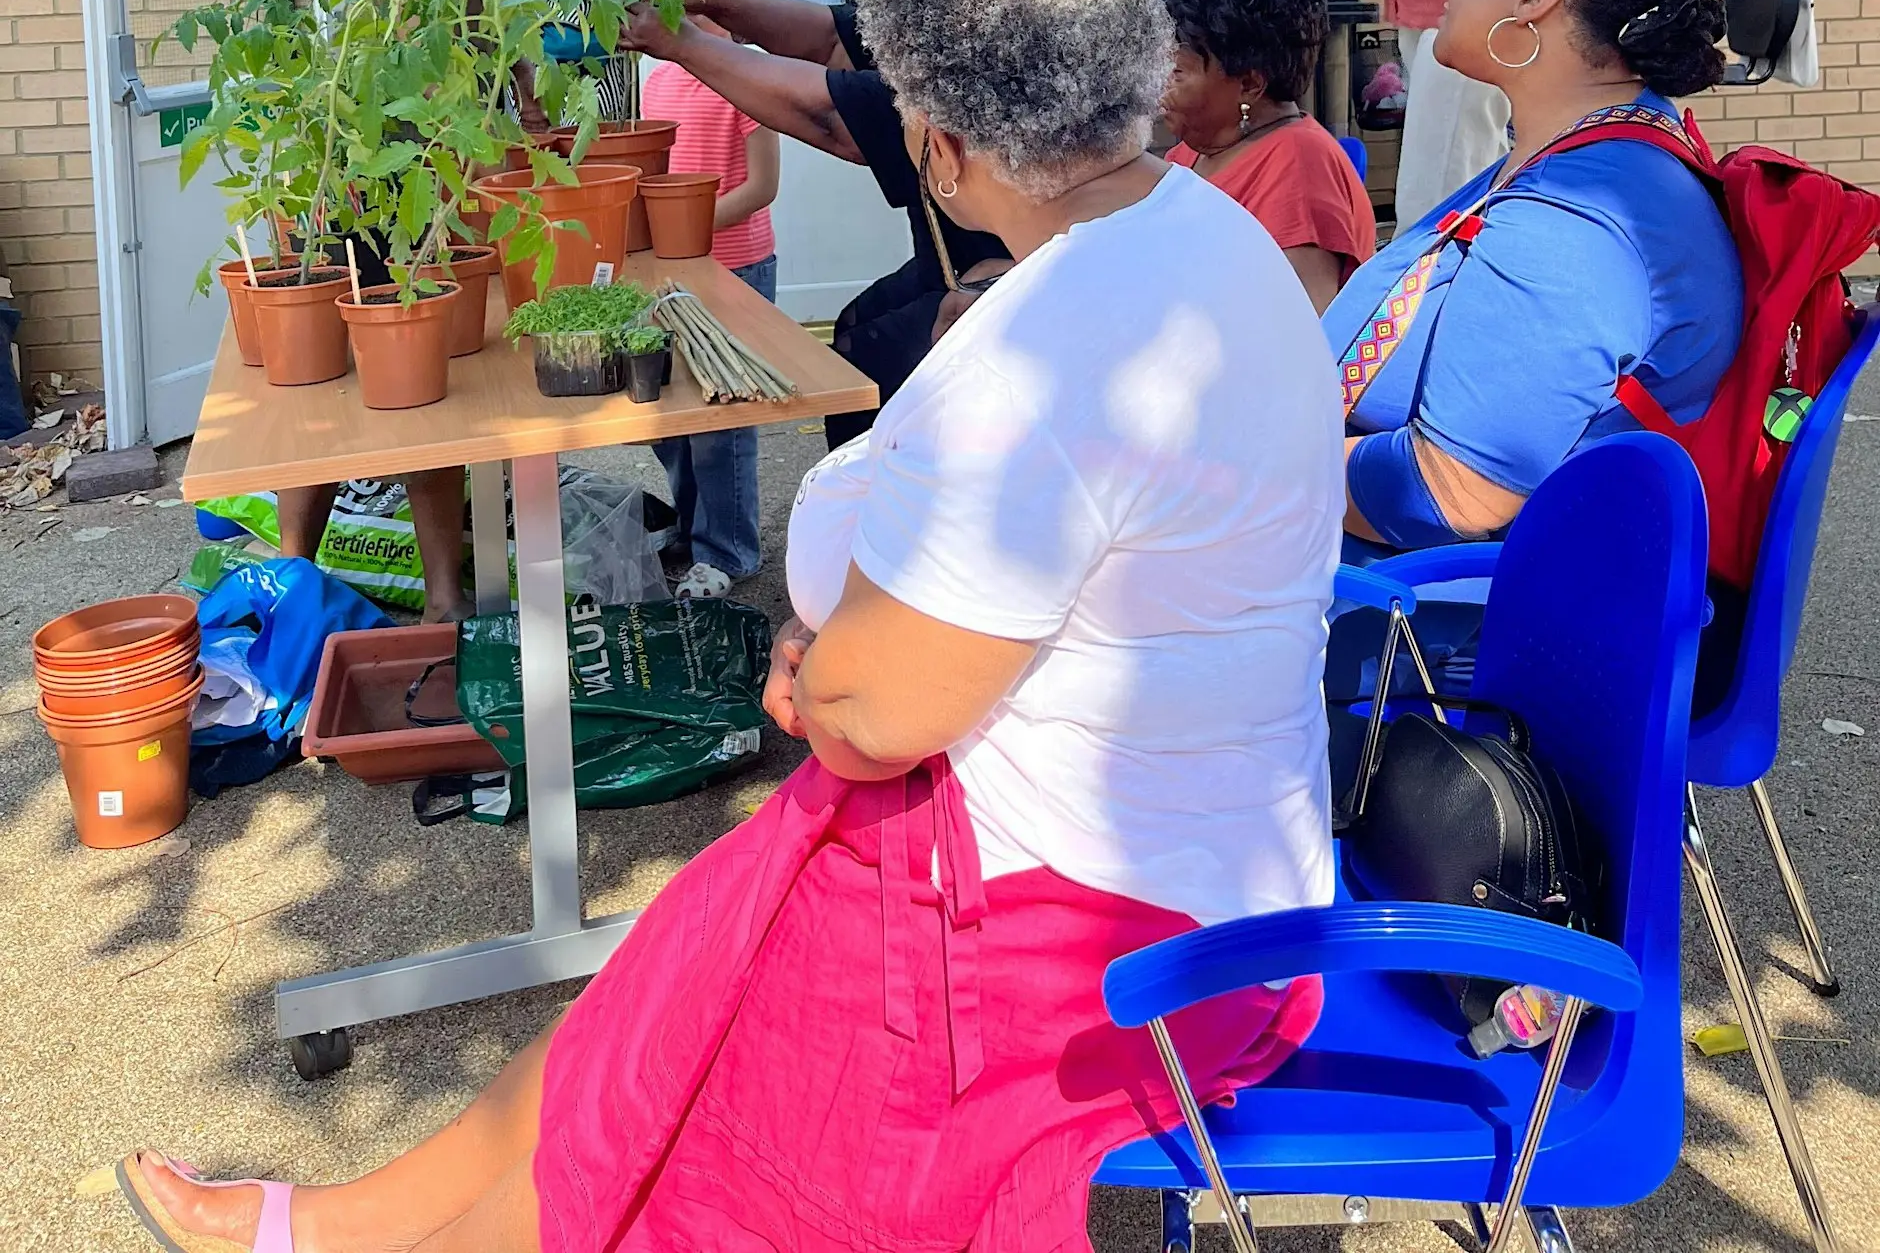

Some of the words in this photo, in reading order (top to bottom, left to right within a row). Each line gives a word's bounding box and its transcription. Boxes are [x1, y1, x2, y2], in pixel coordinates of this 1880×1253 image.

[373, 483, 402, 512] 100%
[326, 529, 415, 561] FertileFibre
[339, 554, 362, 564] Natural
[570, 603, 615, 697] VALUE
[633, 631, 645, 653] low
[622, 663, 636, 685] M&S
